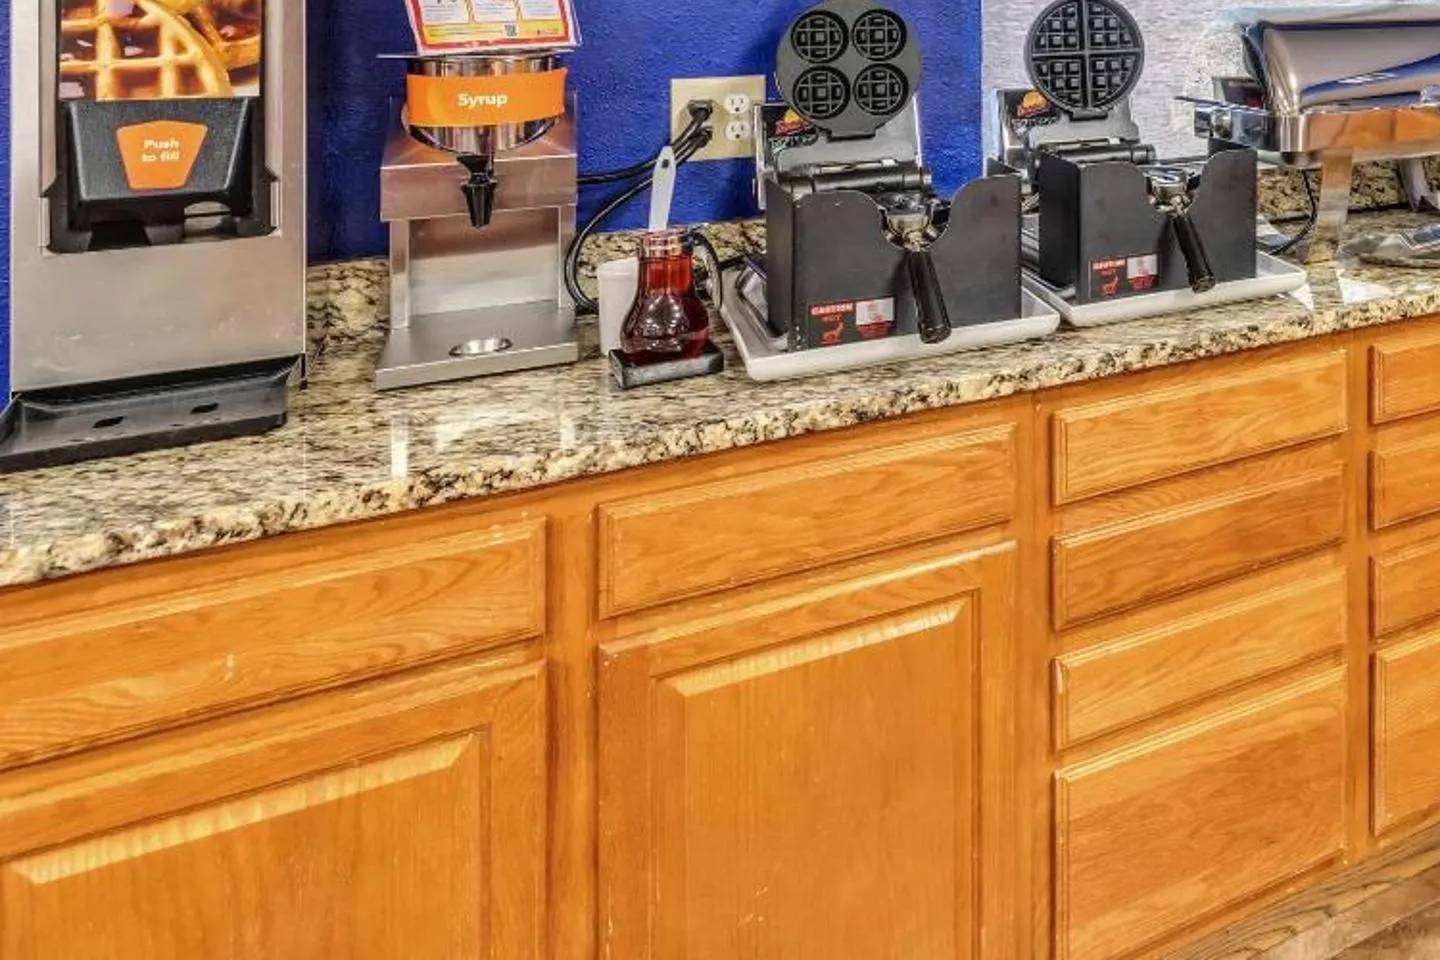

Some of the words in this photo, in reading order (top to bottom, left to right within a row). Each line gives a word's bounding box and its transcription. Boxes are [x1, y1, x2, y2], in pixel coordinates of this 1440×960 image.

[457, 92, 508, 109] Syrup
[143, 137, 180, 149] Push
[142, 153, 157, 162] to
[160, 150, 180, 162] fill
